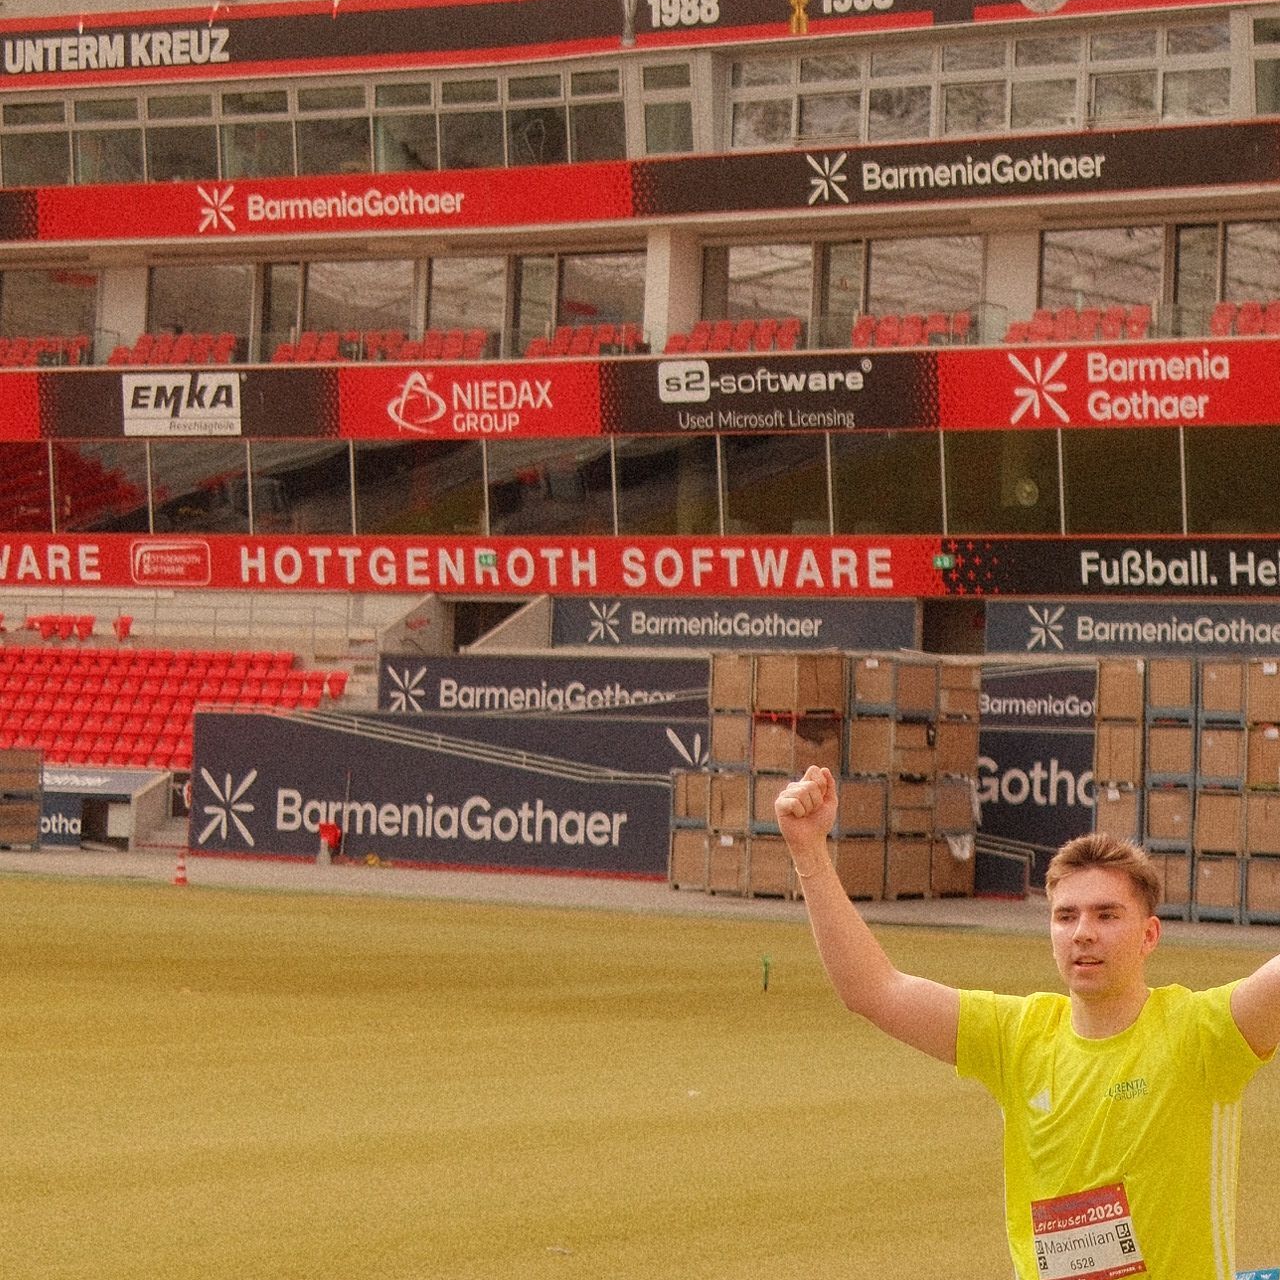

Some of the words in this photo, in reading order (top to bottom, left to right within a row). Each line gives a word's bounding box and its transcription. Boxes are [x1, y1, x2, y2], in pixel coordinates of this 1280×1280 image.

[4, 31, 125, 74] UNTERM
[131, 27, 230, 69] KREUZ
[862, 151, 1106, 192] BarmeniaGothaer
[247, 188, 465, 222] BarmeniaGothaer
[1087, 348, 1230, 384] Barmenia
[131, 371, 234, 418] EMKA
[452, 379, 553, 412] NIEDAX
[1087, 388, 1210, 424] Gothaer
[452, 411, 521, 433] GROUP
[678, 411, 715, 430] Used
[718, 410, 786, 429] Microsoft
[789, 408, 856, 429] Licensing
[240, 546, 598, 588] HOTTGENROTH
[622, 546, 894, 590] SOFTWARE
[1080, 548, 1219, 588] Fußball.
[631, 611, 823, 639] BarmeniaGothaer
[980, 693, 1095, 718] BarmeniaGo
[277, 789, 628, 847] BarmeniaGothaer
[1087, 1201, 1124, 1221] 2026
[1044, 1231, 1115, 1255] Maximilian
[1070, 1256, 1095, 1271] 6528
